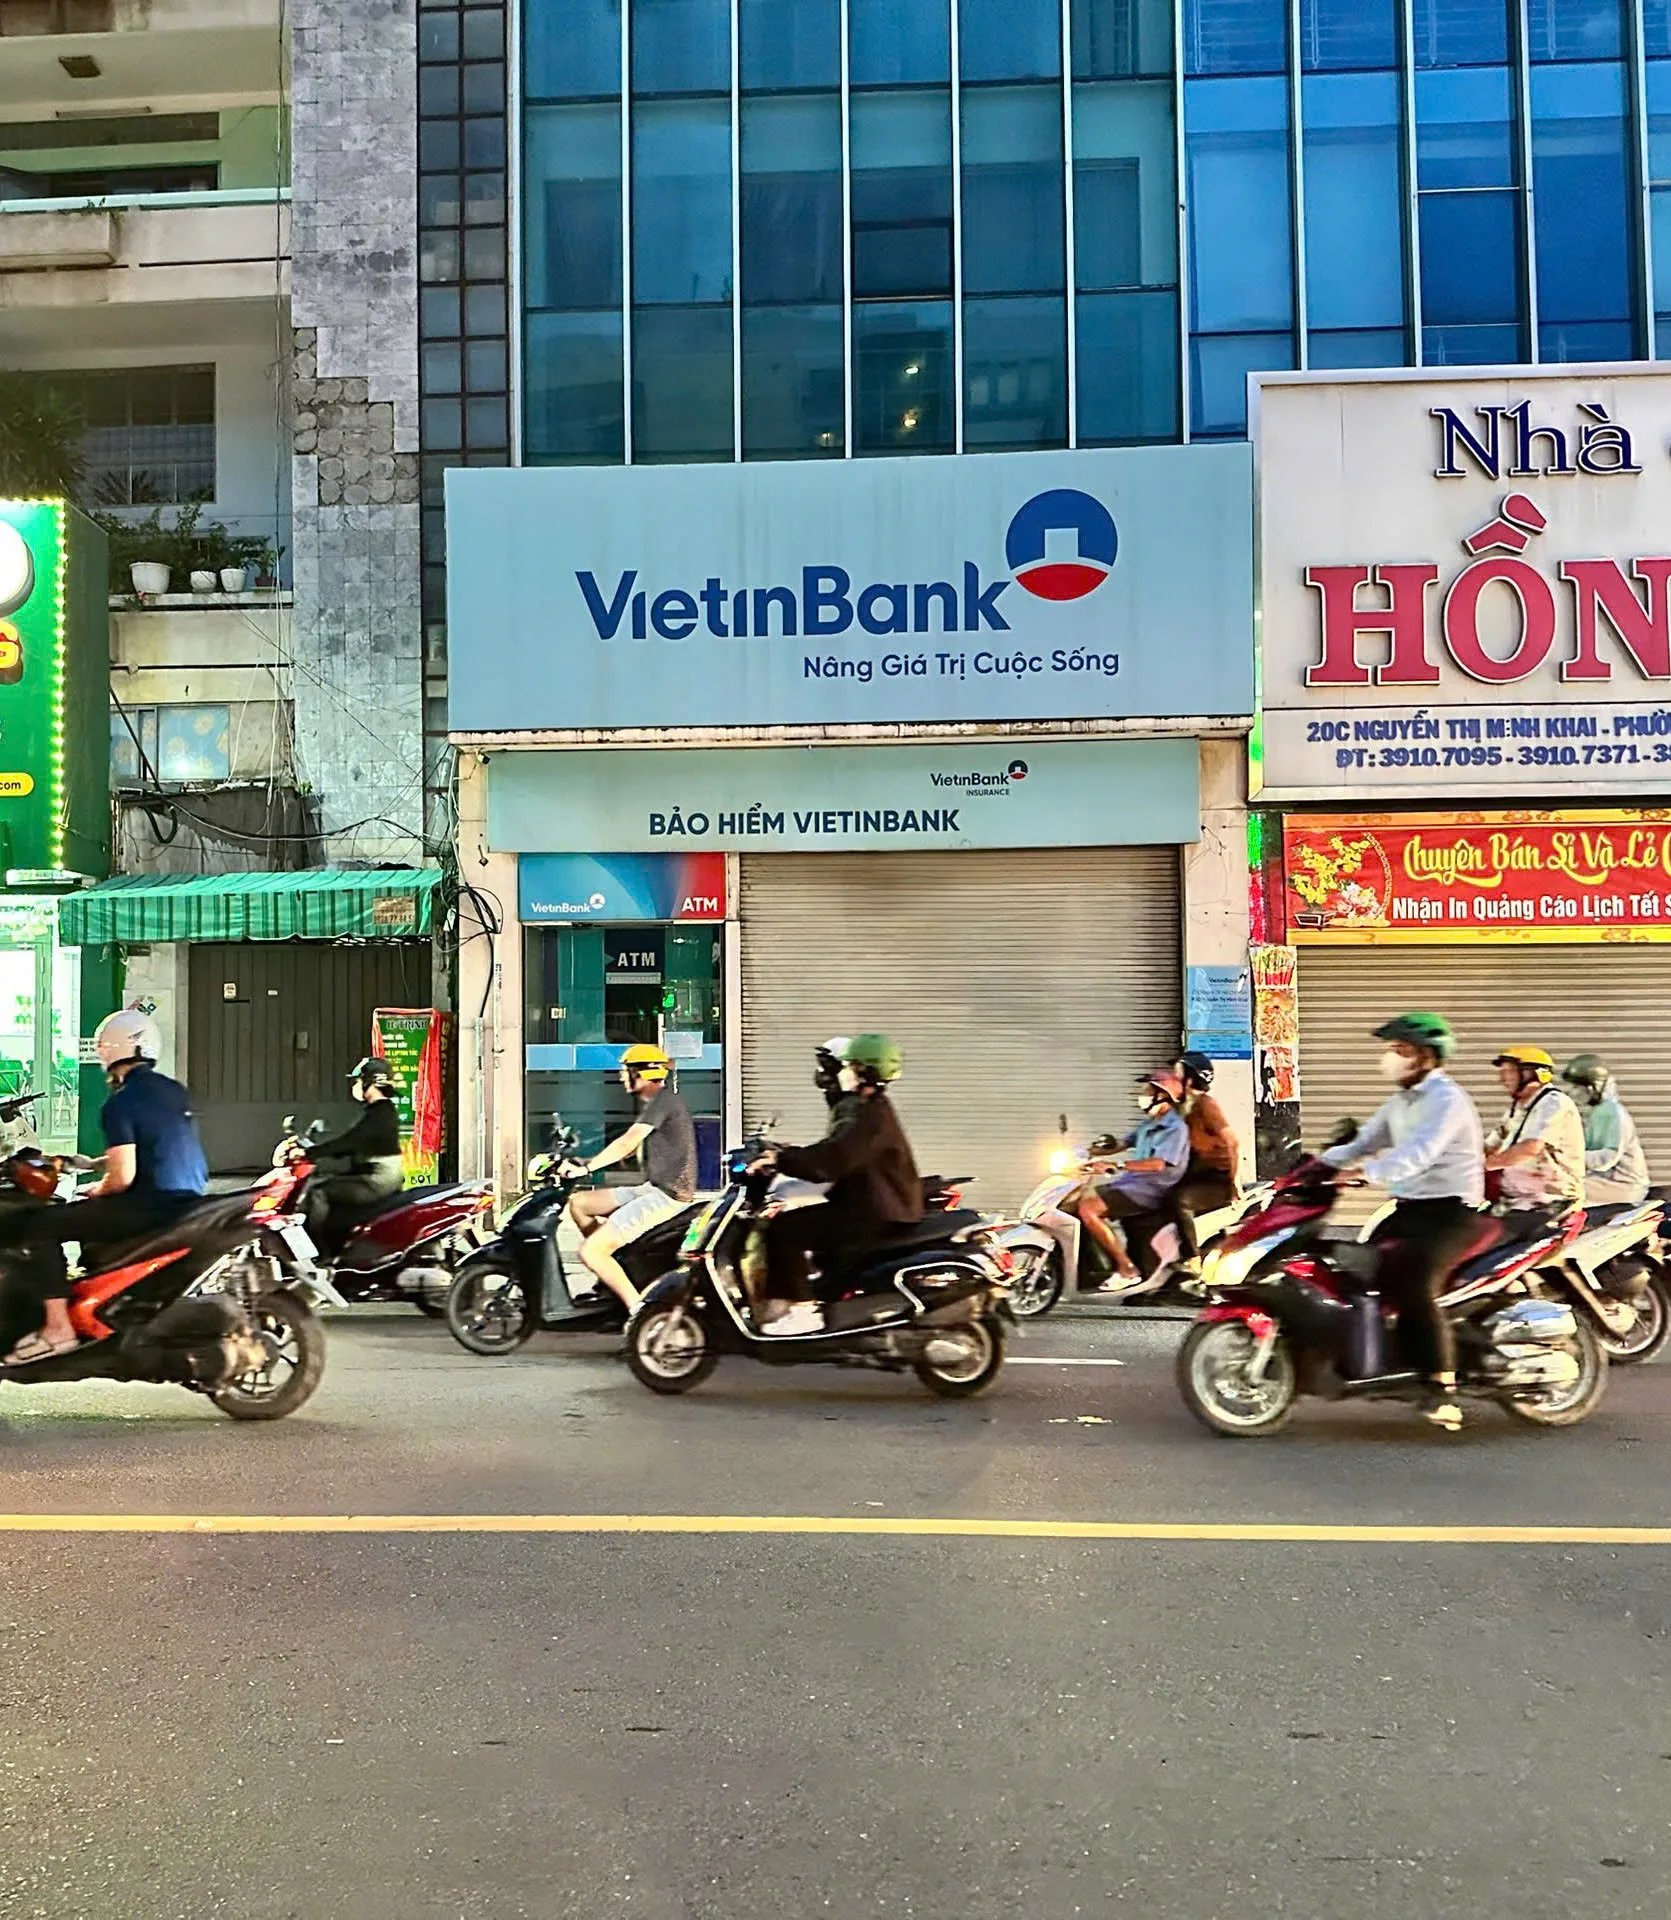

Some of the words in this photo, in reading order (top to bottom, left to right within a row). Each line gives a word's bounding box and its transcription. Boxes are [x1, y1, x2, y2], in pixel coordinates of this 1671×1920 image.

[1431, 399, 1643, 478] Nhà
[574, 560, 1012, 641] VietinBank
[803, 655, 874, 682] Nâng
[881, 653, 928, 676] Giá
[935, 652, 966, 681] Trị
[973, 651, 1043, 680] Cuộc
[1051, 646, 1120, 676] Sống
[1306, 721, 1350, 743] 20C
[1354, 709, 1440, 742] NGUYỄN
[1445, 718, 1481, 744] THỊ
[1486, 717, 1541, 739] MNH
[1545, 716, 1598, 738] KHAI
[930, 772, 1010, 787] VietinBank
[965, 788, 1011, 797] INSURANCE
[649, 805, 710, 836] BẢO
[717, 801, 785, 835] HIỂM
[793, 808, 961, 834] VIETINBANK
[1403, 834, 1503, 888] Chuyên
[1488, 832, 1545, 870] Bán
[1580, 831, 1619, 869] Và
[1620, 829, 1659, 868] Lẻ
[530, 901, 591, 914] VietinBank
[681, 897, 719, 913] ATM
[1392, 896, 1443, 924] Nhận
[1448, 896, 1468, 919] In
[1472, 892, 1535, 921] Quảng
[1540, 894, 1578, 918] Cáo
[1582, 894, 1625, 922] Lịch
[1628, 889, 1660, 917] Tết
[616, 952, 656, 967] ATM
